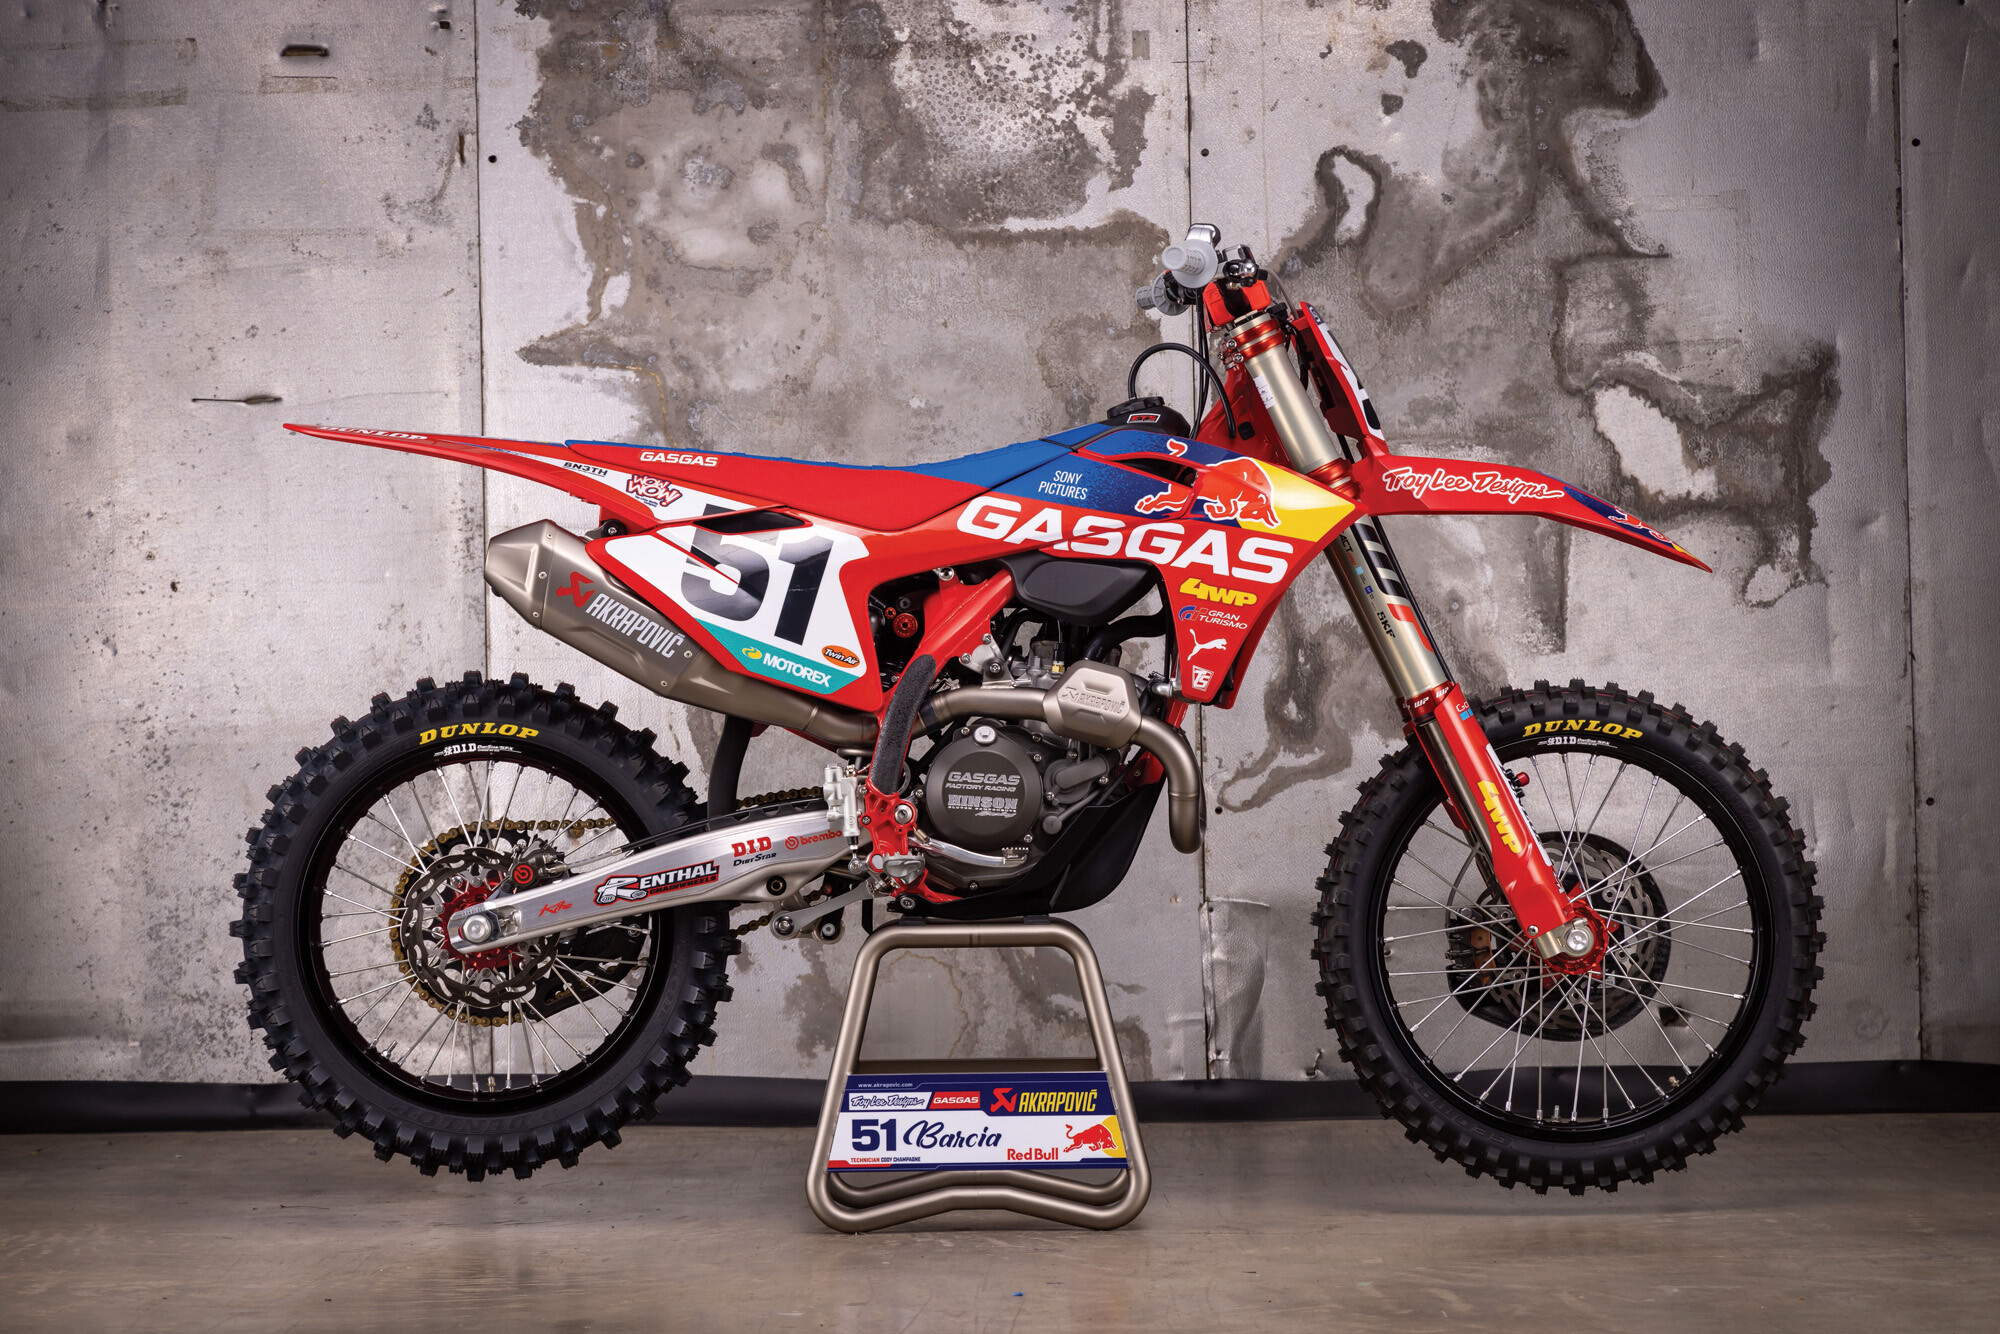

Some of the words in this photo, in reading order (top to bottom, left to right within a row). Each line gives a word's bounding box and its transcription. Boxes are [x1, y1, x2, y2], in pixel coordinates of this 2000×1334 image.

[640, 451, 719, 467] GASGAS
[563, 462, 608, 475] BN3TH
[1053, 470, 1082, 485] SONY
[1383, 466, 1431, 498] Troy
[1430, 468, 1471, 491] Lee
[1472, 471, 1564, 504] Designs
[1038, 481, 1088, 500] PICTURES
[956, 495, 1294, 584] GASGAS
[1339, 531, 1353, 553] ACT
[681, 503, 834, 646] 51
[1199, 615, 1248, 629] TURISMO
[1208, 610, 1240, 621] GRAN
[1377, 611, 1396, 638] SKF
[824, 648, 844, 661] Twin
[844, 656, 858, 666] Air
[763, 652, 832, 687] MOTOREX
[1414, 696, 1429, 708] WP
[420, 722, 539, 745] DUNLOP
[1522, 719, 1643, 739] DUNLOP
[945, 782, 983, 790] FACTORY
[947, 771, 1021, 785] GASGAS
[948, 794, 1018, 810] HINSON
[800, 829, 842, 845] brembo
[731, 836, 772, 858] D.I.D
[650, 875, 717, 895] CHAINWHEELS
[851, 1095, 869, 1109] Troy
[870, 1095, 887, 1106] Lee
[887, 1094, 925, 1108] Designs
[933, 1096, 979, 1105] GASGAS
[852, 1118, 897, 1151] 51
[902, 1119, 1002, 1149] Barcia
[1007, 1148, 1032, 1160] Red
[1034, 1147, 1059, 1160] Bull
